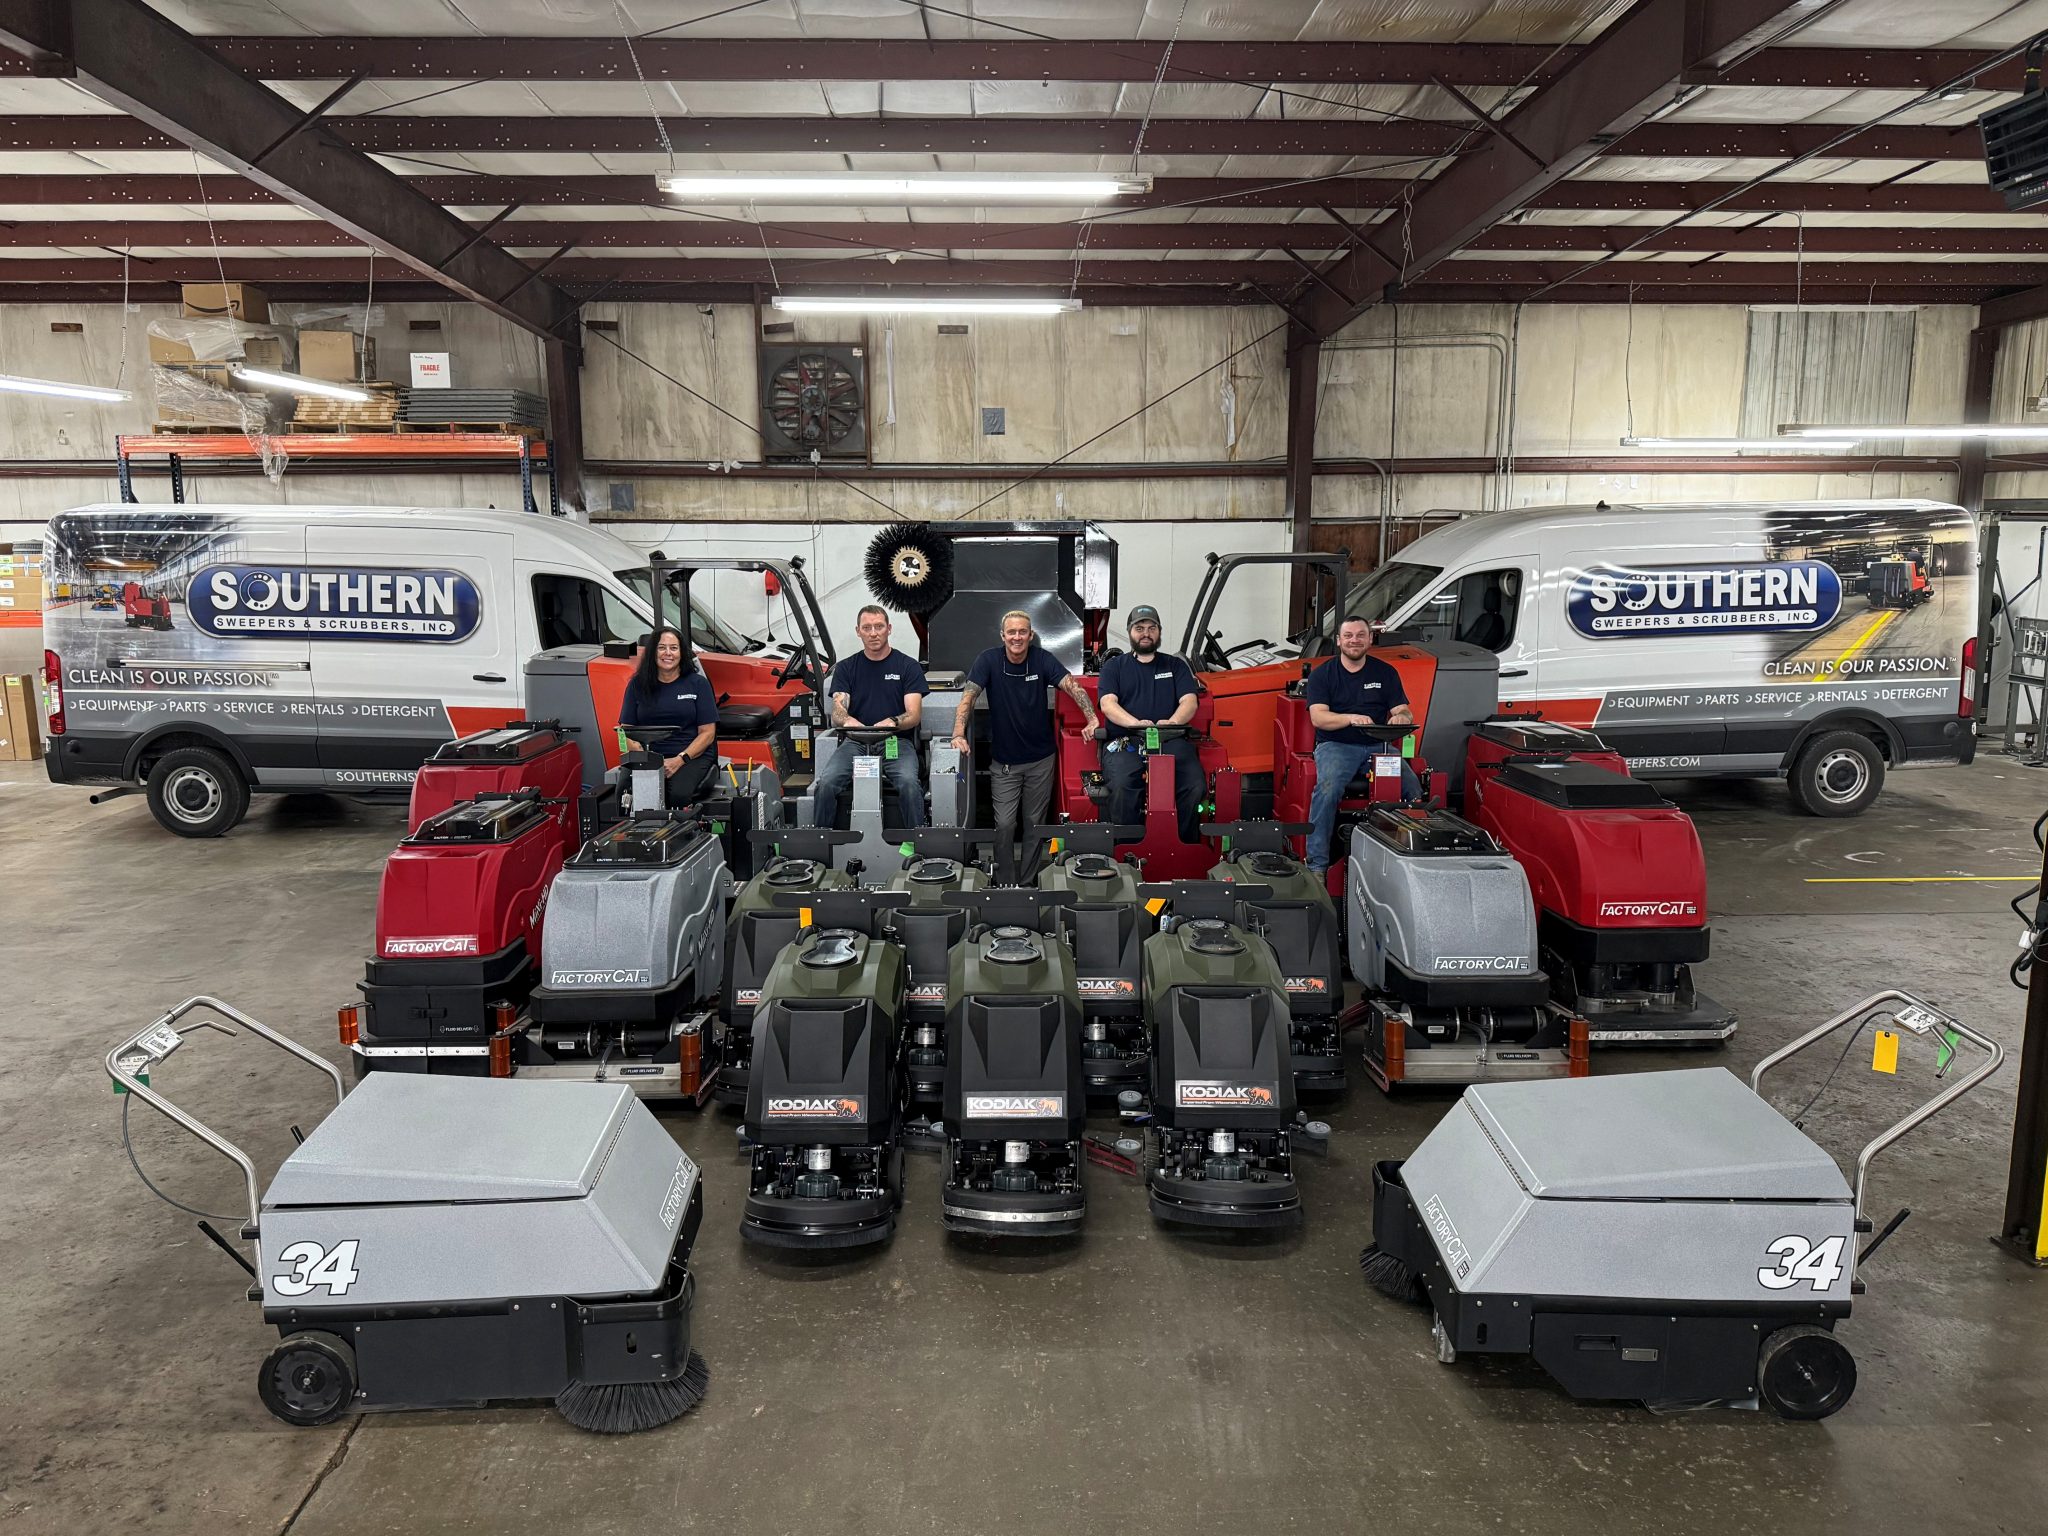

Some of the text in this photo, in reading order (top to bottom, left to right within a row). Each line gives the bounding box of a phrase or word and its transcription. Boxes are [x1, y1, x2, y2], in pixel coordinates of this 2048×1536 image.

[210, 571, 454, 615] SOUTHERN
[1590, 567, 1818, 612] SOUTHERN
[216, 617, 453, 633] SWEEPERS & SCRUBBERS, INC.
[1595, 612, 1815, 629] SWEEPERS & SCRUBBERS, INC.
[1763, 661, 1816, 676] CLEAN
[1820, 661, 1834, 674] IS
[1839, 659, 1874, 674] OUR
[1878, 657, 1950, 672] PASSION.
[69, 669, 125, 684] CLEAN
[130, 670, 145, 684] IS
[150, 671, 189, 685] OUR
[193, 671, 272, 687] PASSION.
[1704, 693, 1740, 705] PARTS
[1754, 691, 1802, 704] SERVICE
[1817, 689, 1868, 702] RENTALS
[1881, 687, 1949, 700] DETERGENT
[78, 699, 154, 712] EQUIPMENT
[169, 700, 207, 713] PARTS
[223, 702, 275, 714] SERVICE
[1617, 695, 1690, 709] EQUIPMENT
[290, 703, 345, 716] RENTALS
[361, 705, 437, 718] DETERGENT
[336, 771, 417, 782] SOUTHERNS
[1182, 1086, 1249, 1098] KODIAK
[768, 1099, 837, 1111] KODIAK
[969, 1098, 1038, 1110] KODIAK
[272, 1239, 360, 1297] 34
[1757, 1234, 1847, 1291] 34
